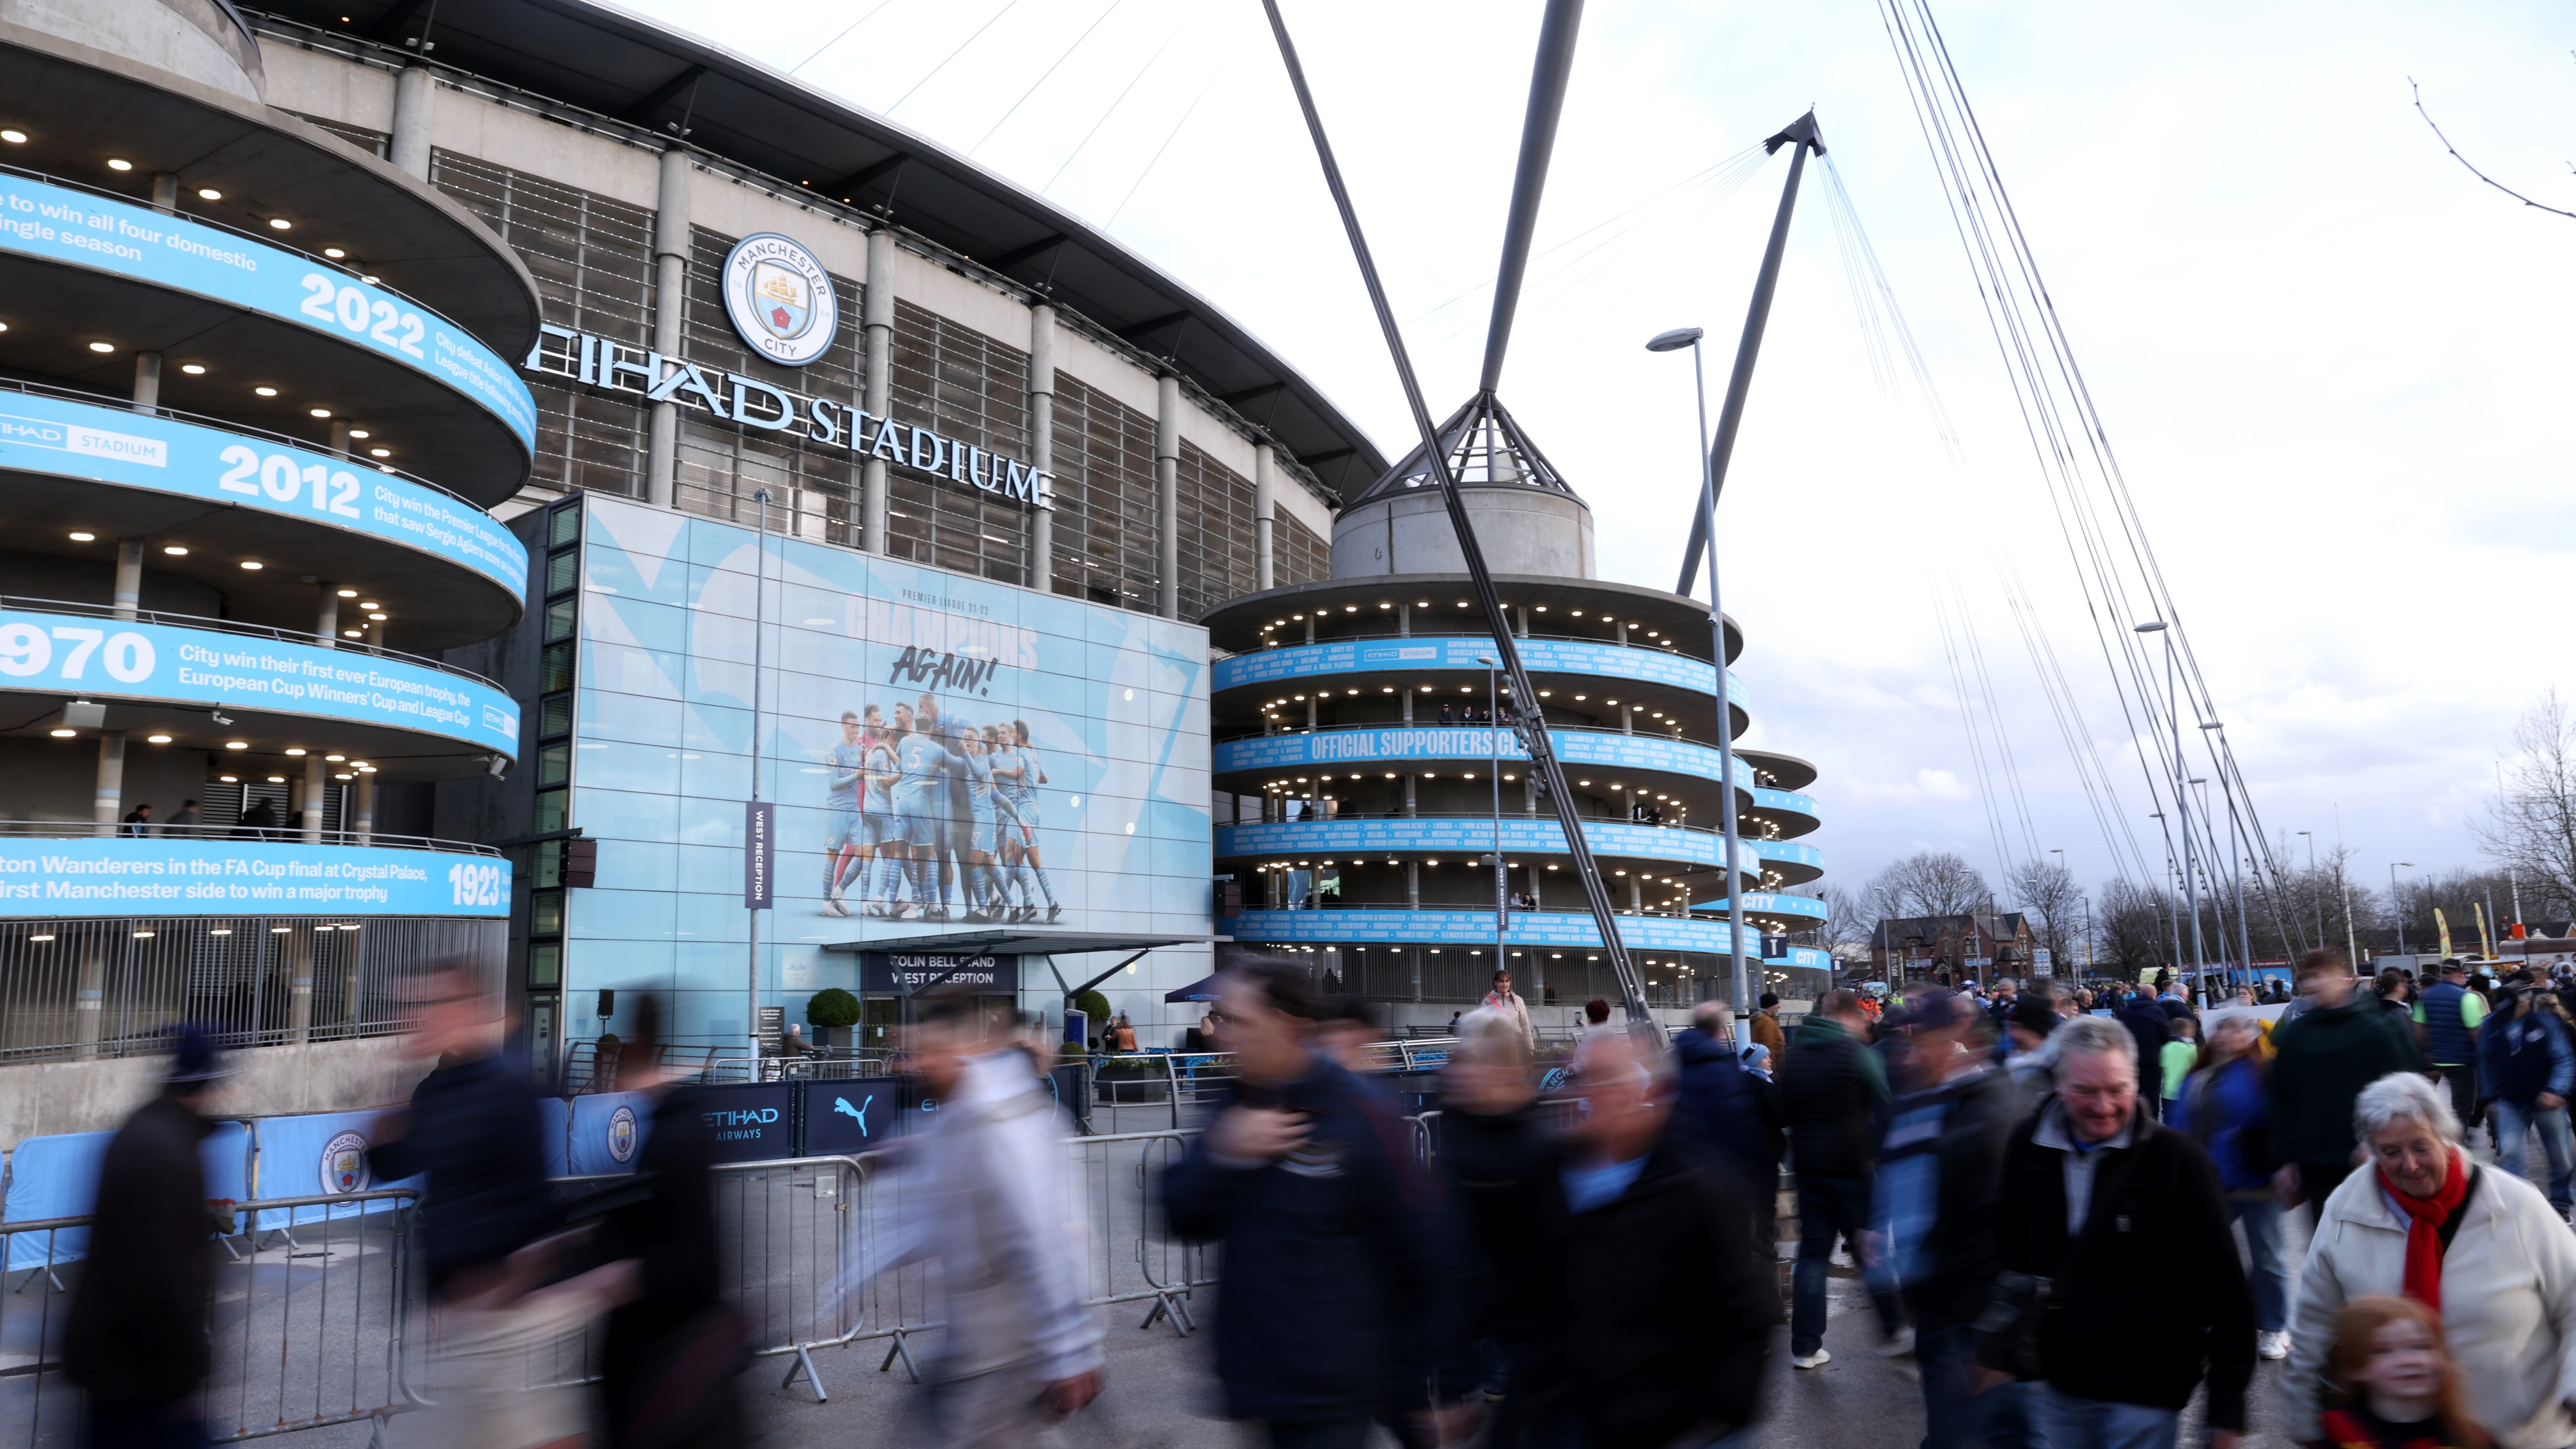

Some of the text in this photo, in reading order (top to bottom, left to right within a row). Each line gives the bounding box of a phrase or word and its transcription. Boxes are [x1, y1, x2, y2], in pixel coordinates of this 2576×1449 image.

[8, 194, 257, 272] to win all four domestic
[61, 231, 142, 261] season
[738, 243, 826, 296] MANCHESTER
[733, 280, 742, 289] 18
[301, 273, 425, 361] 2022
[436, 331, 456, 356] City
[457, 345, 483, 371] defeat
[483, 361, 502, 385] Aston
[765, 339, 797, 357] CITY
[435, 349, 468, 380] League
[469, 370, 484, 390] title
[82, 435, 155, 458] STADIUM
[810, 398, 1040, 505] STADIUM
[219, 445, 360, 519] 2012
[374, 486, 498, 548] City win the Premier League
[374, 507, 400, 526] that
[401, 517, 425, 534] saw
[426, 522, 456, 546] Sergio
[457, 535, 484, 554] Agüero
[902, 589, 988, 615] PREMIER LEAGUE 21-22
[845, 591, 1038, 672] CHAMPIONS
[179, 644, 471, 707] City win their first ever European trophy, the
[889, 644, 999, 697] AGAIN!
[179, 667, 470, 729] European Cup Winners' Cup and League Cup
[1312, 732, 1377, 759] OFFICIAL
[1380, 730, 1493, 756] SUPPORTERS
[41, 856, 164, 875] Wanderers
[168, 858, 186, 875] in
[190, 859, 222, 875] the
[225, 859, 249, 875] FA
[252, 860, 286, 879] Cup
[289, 861, 322, 878] final
[325, 863, 339, 878] at
[342, 863, 388, 881] Crystal
[390, 865, 427, 883] Palace,
[755, 842, 763, 900] RECEPTION
[46, 881, 182, 899] Manchester
[185, 882, 226, 899] side
[229, 884, 248, 899] to
[251, 883, 283, 899] win
[286, 886, 297, 899] a
[300, 884, 342, 902] major
[344, 885, 388, 903] trophy
[448, 863, 499, 906] 1923
[1741, 895, 1776, 909] CITY
[929, 956, 957, 967] BELL
[960, 957, 995, 967] SAND
[1770, 939, 1778, 955] T
[1796, 951, 1818, 965] CITY
[930, 973, 993, 984] REPTION
[1834, 960, 1841, 971] R
[611, 1111, 634, 1128] MANCHESTER
[701, 1108, 778, 1127] ETIHAD
[325, 1136, 368, 1161] MANCHESTE
[716, 1129, 761, 1142] AIRWAYS
